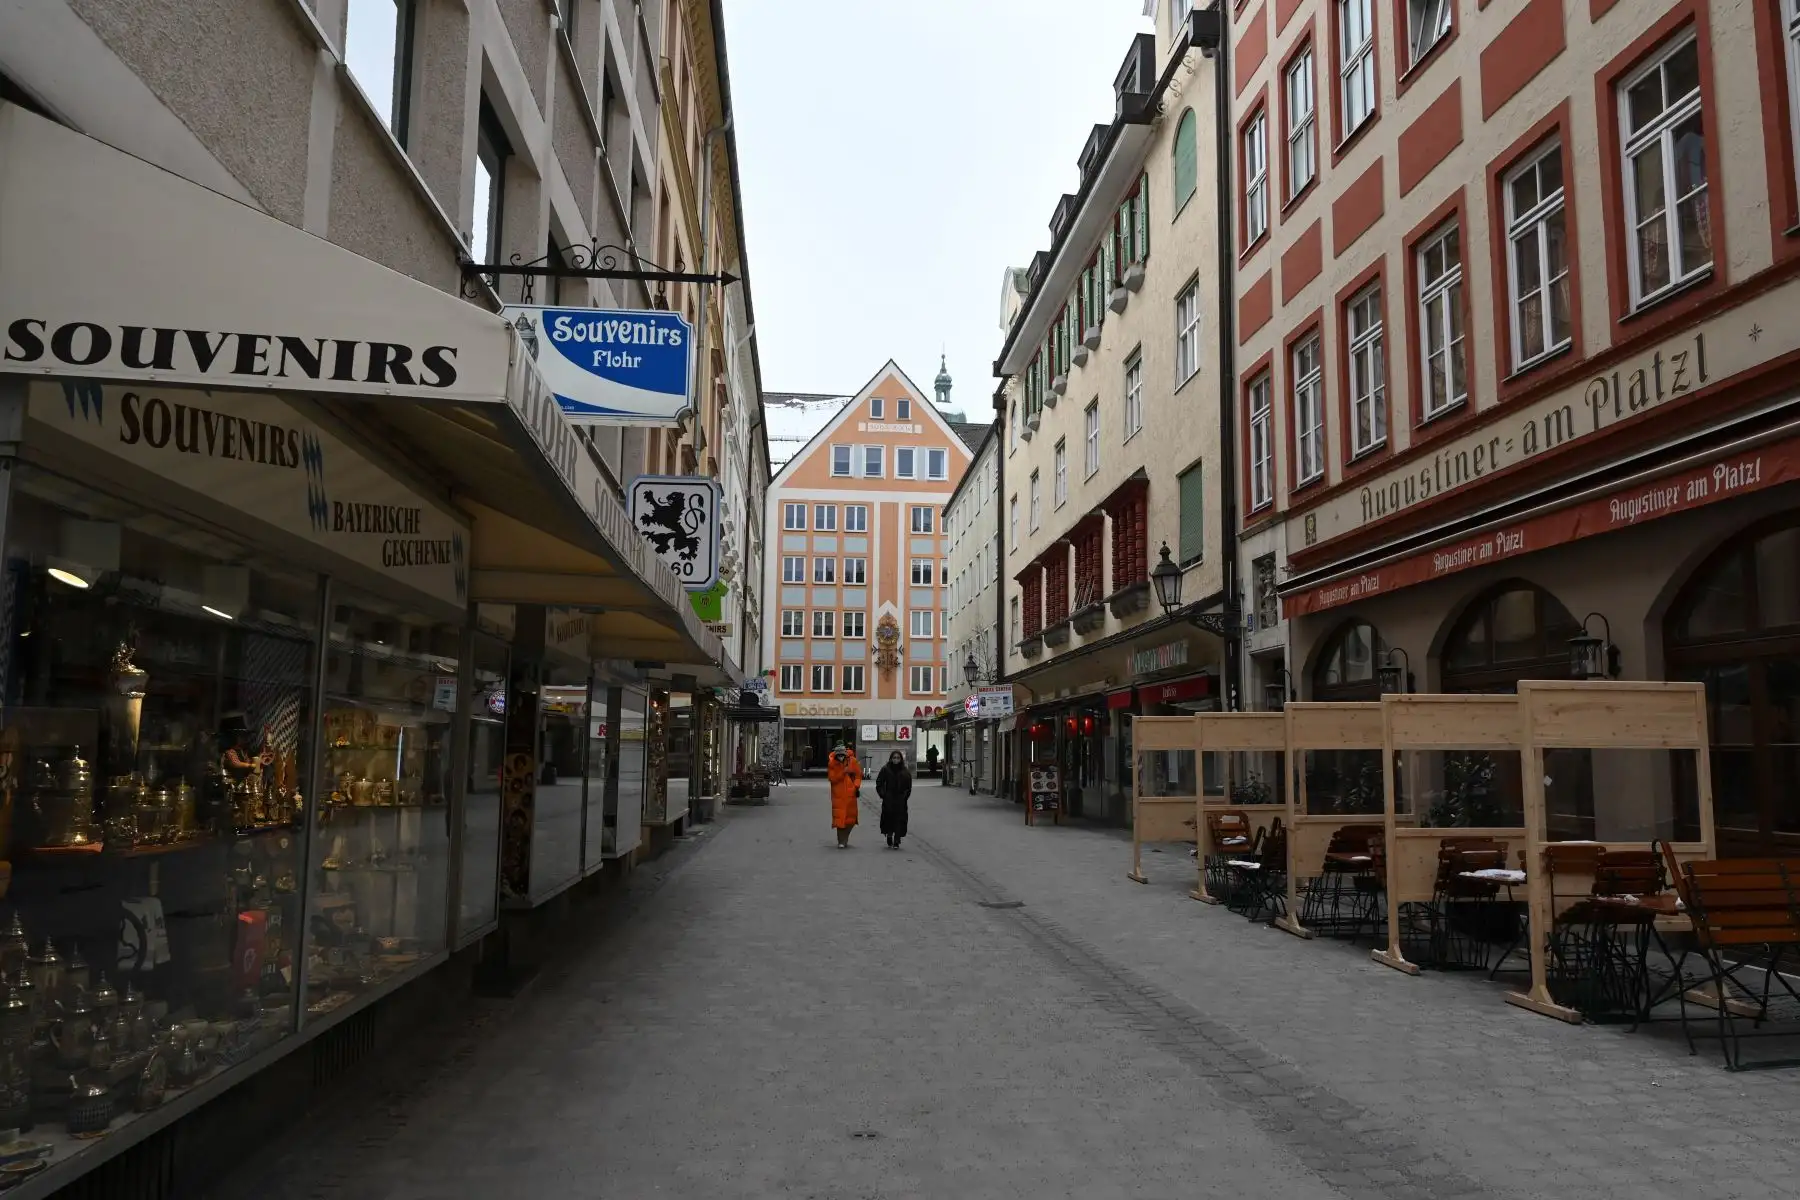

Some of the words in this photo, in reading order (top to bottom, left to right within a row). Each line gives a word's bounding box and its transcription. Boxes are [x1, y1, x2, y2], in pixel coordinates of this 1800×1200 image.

[552, 316, 682, 346] Souvenirs
[4, 318, 458, 388] SOUVENIRS
[592, 350, 642, 369] Flohr
[1585, 332, 1709, 431] Platzl
[119, 391, 300, 469] SOUVENIRS
[522, 354, 578, 491] FLOHR
[1610, 485, 1680, 523] Augustiner
[1687, 476, 1708, 502] am
[1713, 457, 1761, 493] Platzl
[333, 500, 422, 535] BAYERISCHE
[382, 539, 452, 568] GESCHENKE
[1433, 544, 1477, 572] Augustiner
[1480, 541, 1493, 558] am
[1496, 529, 1524, 554] Platzl
[1319, 585, 1348, 606] Augustiner
[1350, 583, 1360, 596] am
[1361, 575, 1379, 592] Platzl
